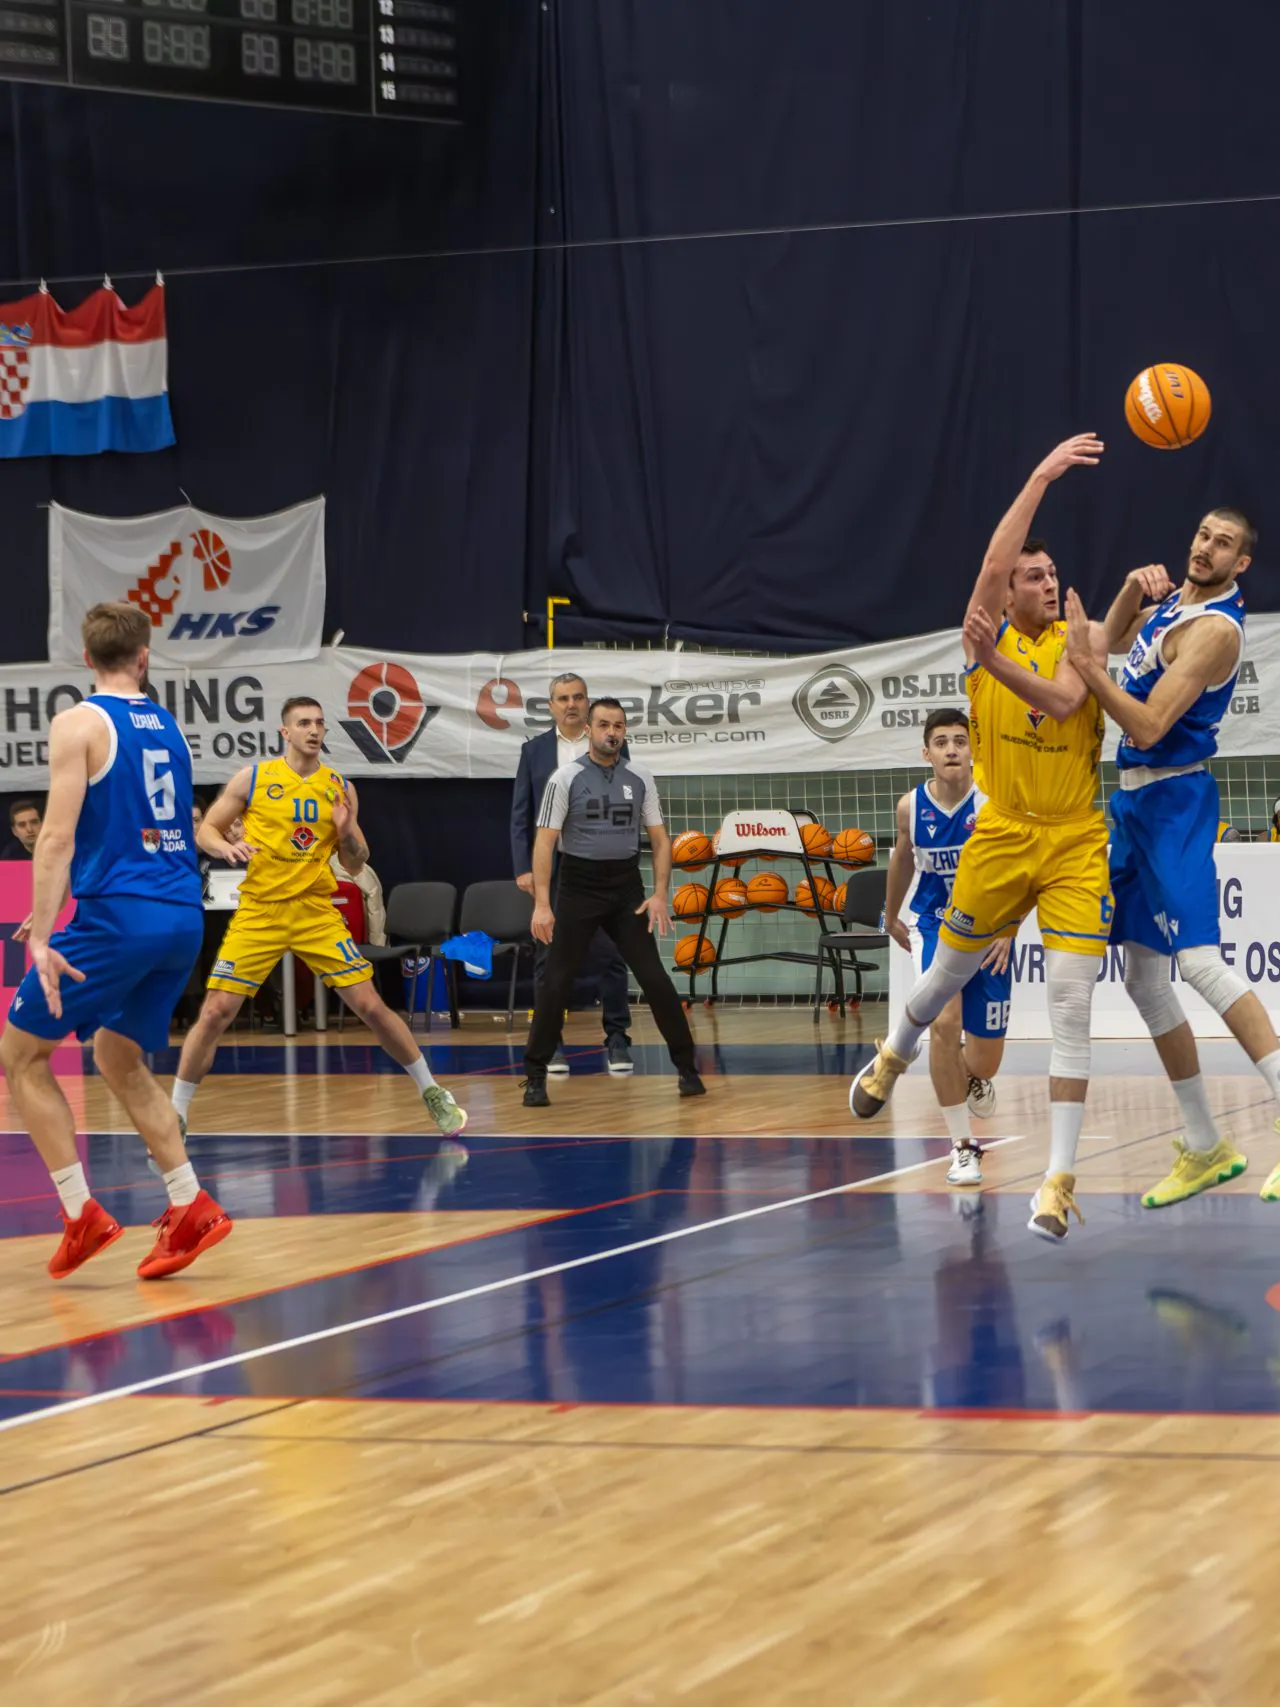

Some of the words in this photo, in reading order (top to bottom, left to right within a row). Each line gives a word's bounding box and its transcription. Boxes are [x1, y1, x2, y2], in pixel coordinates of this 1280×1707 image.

[381, 80, 396, 100] 15
[168, 606, 281, 640] HKS
[663, 678, 766, 694] Grupa
[5, 675, 265, 732] HOING
[475, 677, 762, 730] eseker
[292, 798, 319, 824] 10
[735, 823, 787, 838] Wilson
